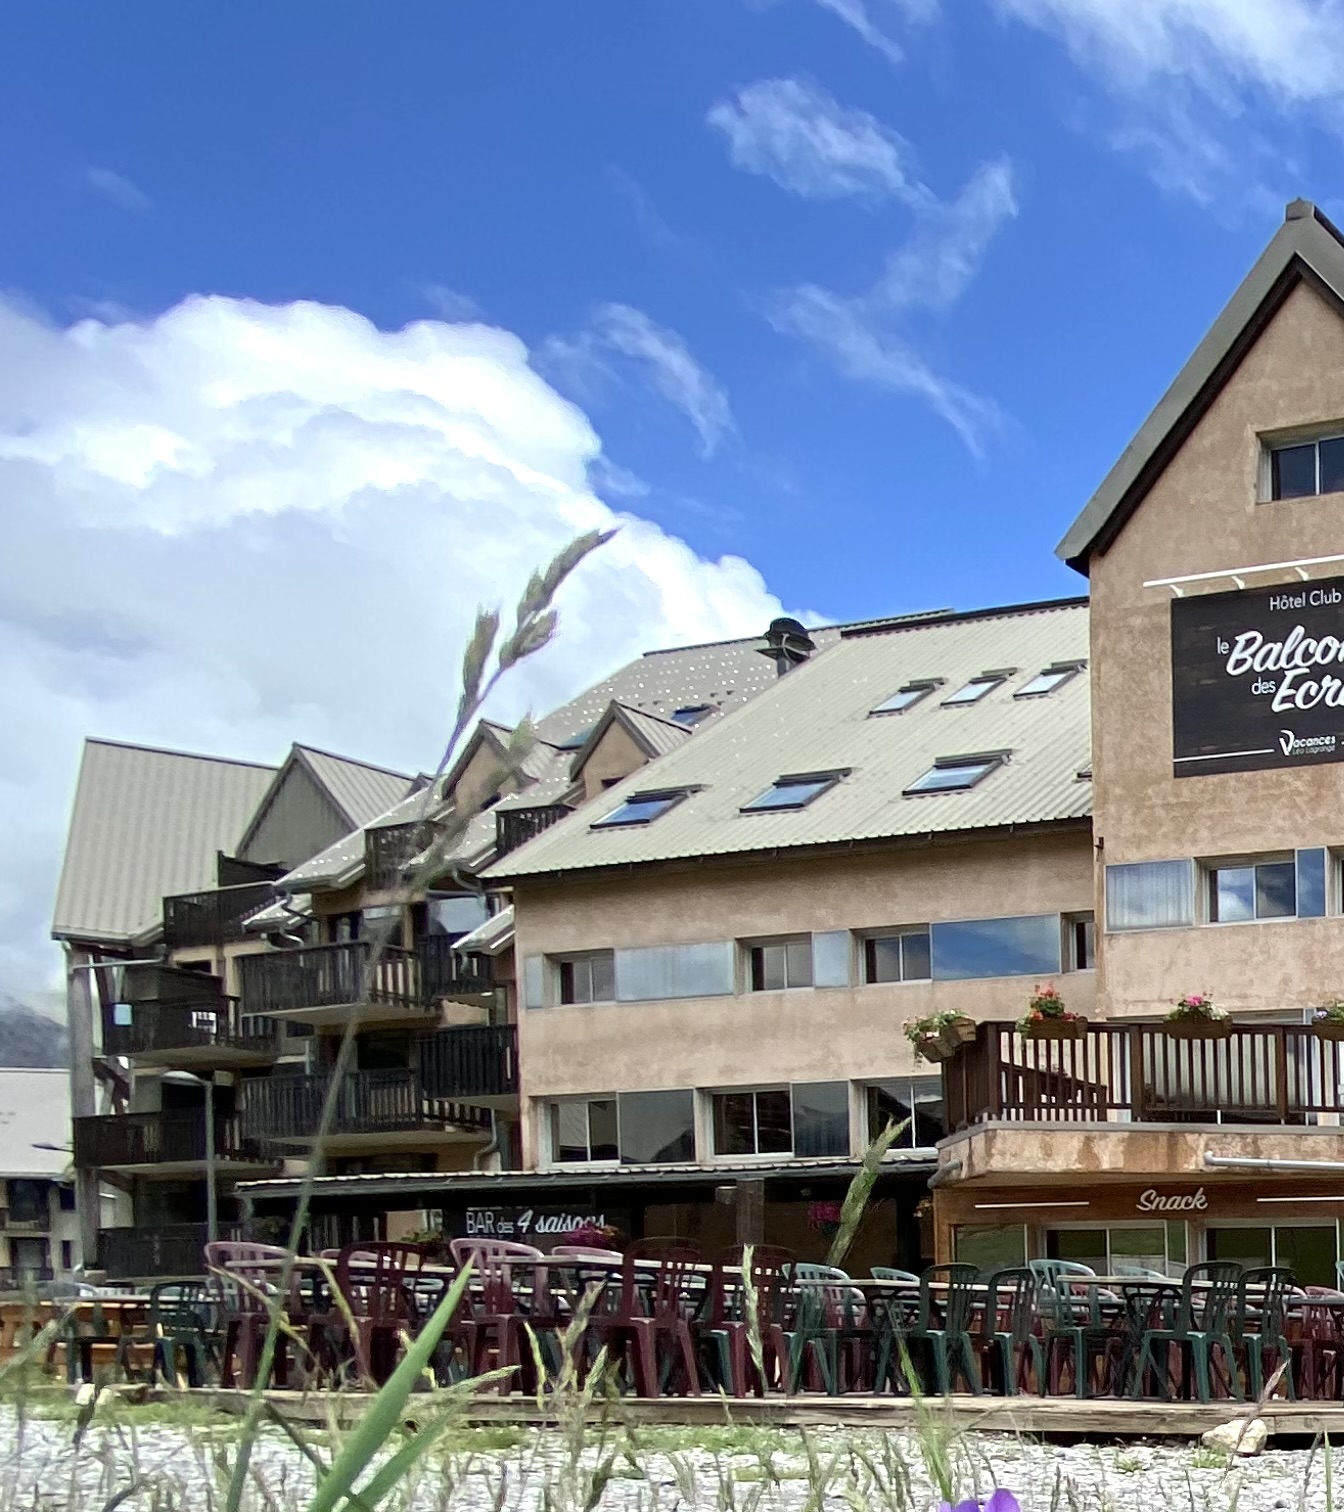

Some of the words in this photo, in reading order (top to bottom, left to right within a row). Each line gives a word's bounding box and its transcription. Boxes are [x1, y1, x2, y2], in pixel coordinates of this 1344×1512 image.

[1269, 594, 1306, 611] Hôtel
[1309, 588, 1342, 606] Club
[1217, 636, 1230, 654] le
[1251, 676, 1277, 695] des
[1279, 729, 1336, 756] Vacances
[1135, 1187, 1208, 1211] Snack
[466, 1211, 495, 1234] BAR
[496, 1216, 514, 1234] des
[517, 1209, 534, 1233] 4
